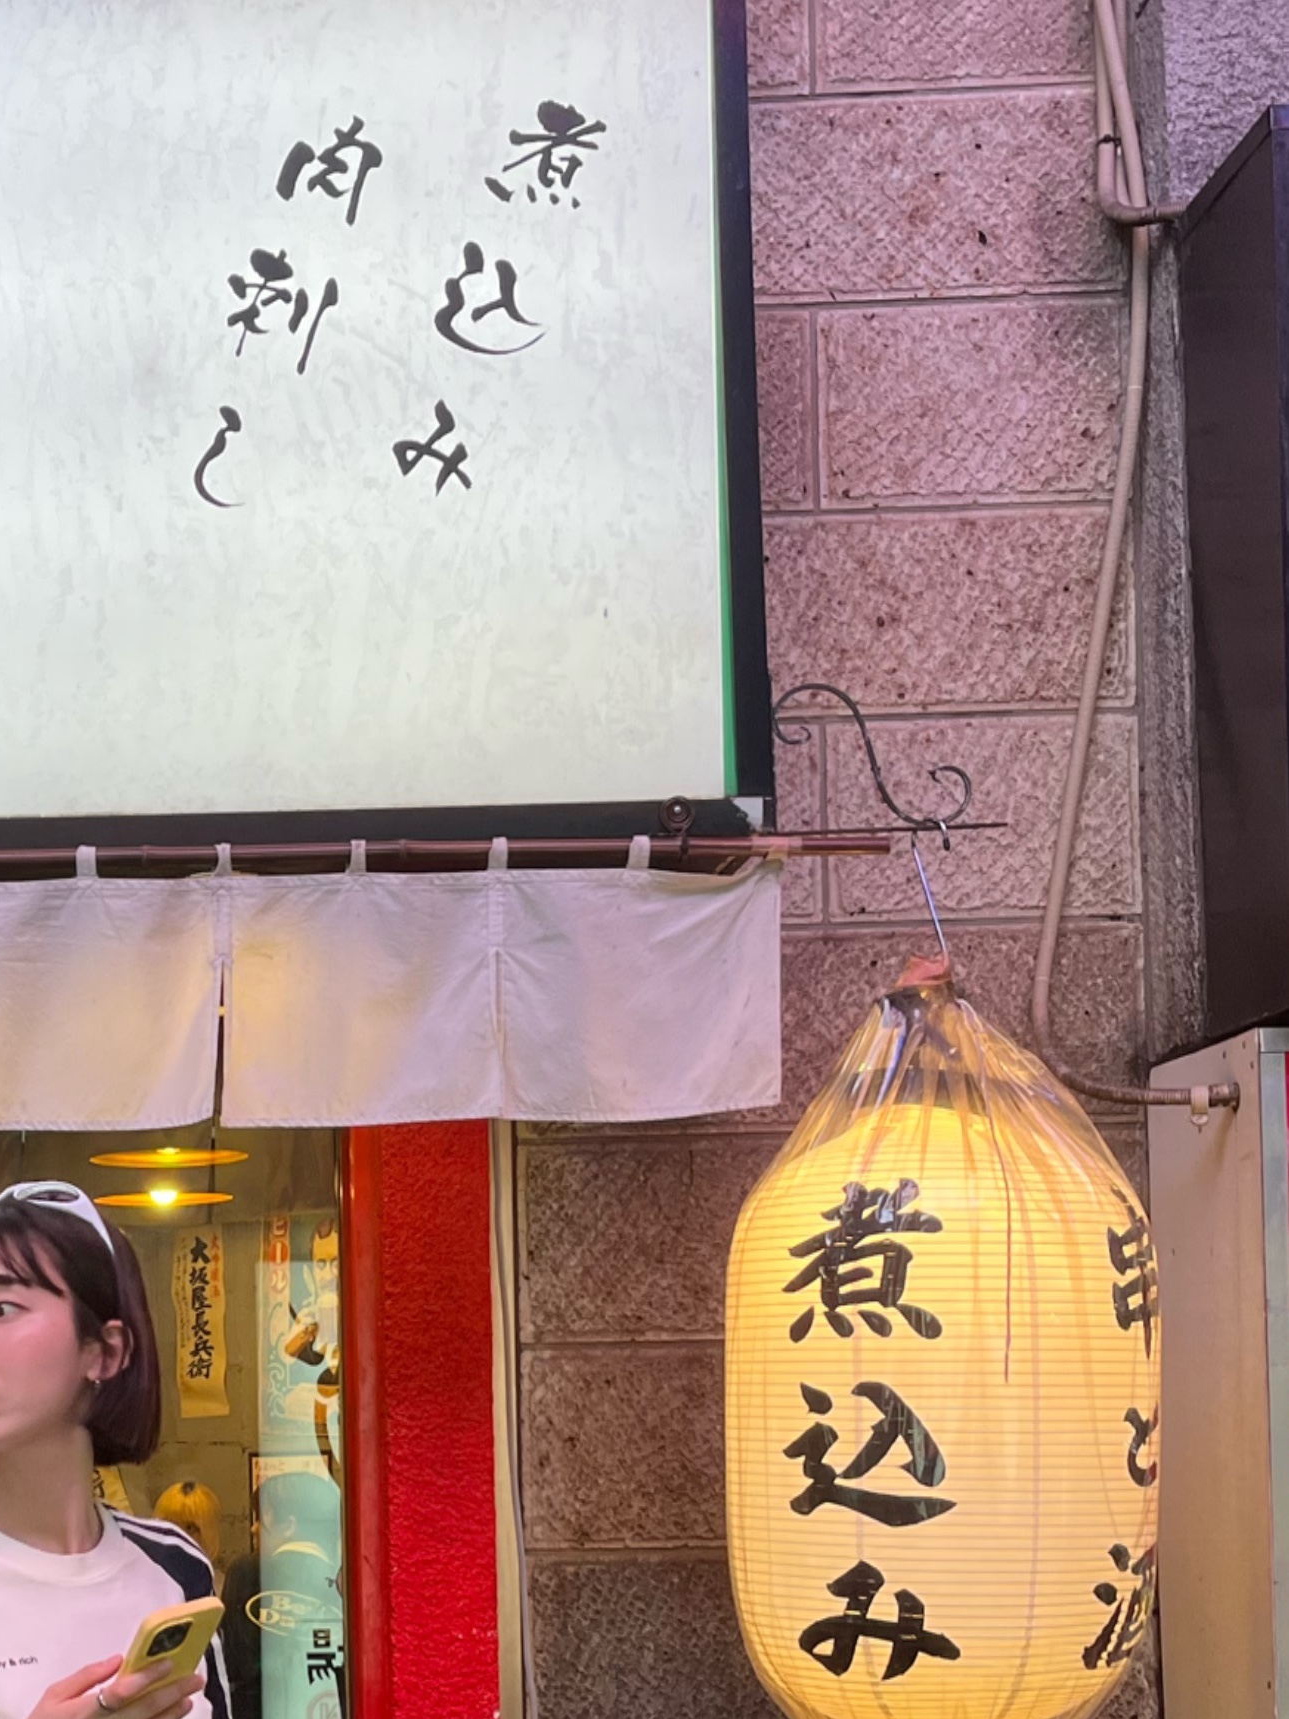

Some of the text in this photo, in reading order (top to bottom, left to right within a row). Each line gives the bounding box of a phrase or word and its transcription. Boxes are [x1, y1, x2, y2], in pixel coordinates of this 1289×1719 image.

[391, 98, 607, 497] 煮込み
[781, 1177, 962, 1681] 煮込み
[18, 1655, 38, 1667] rich
